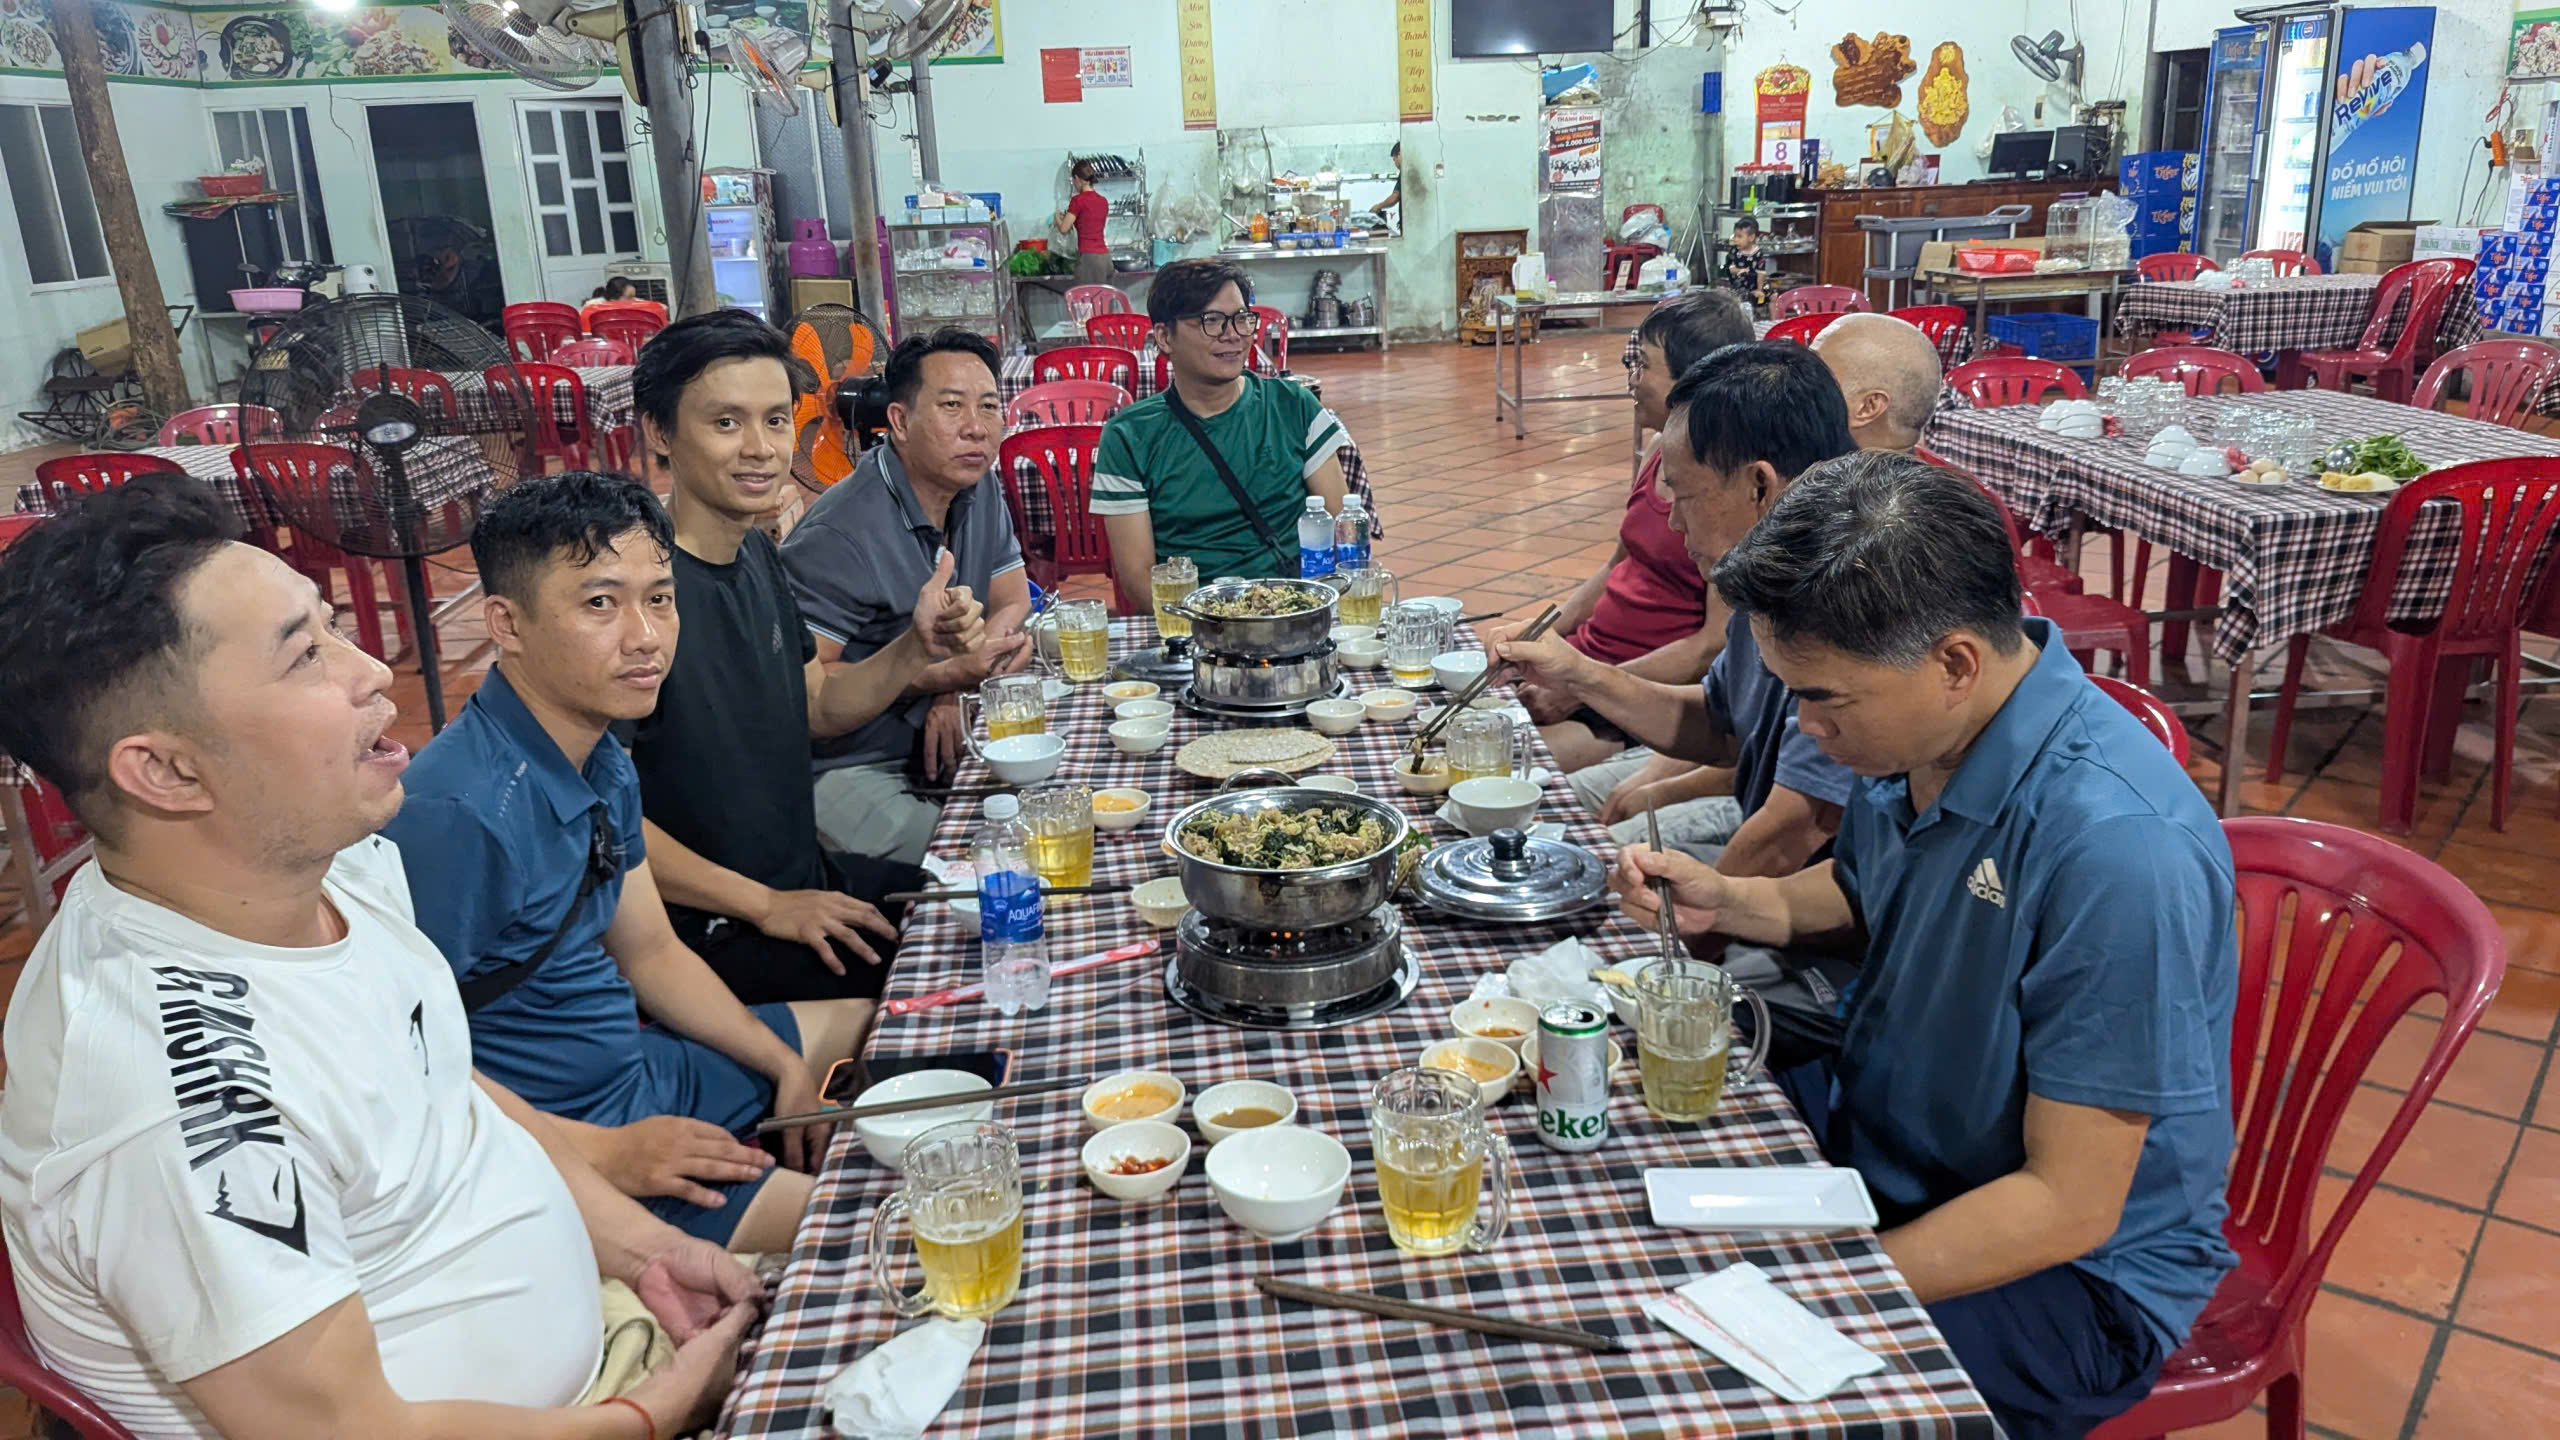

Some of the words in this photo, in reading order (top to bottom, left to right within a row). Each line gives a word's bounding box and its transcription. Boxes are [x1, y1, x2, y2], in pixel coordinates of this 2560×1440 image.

[2333, 70, 2393, 126] Revive
[1774, 141, 1788, 161] 8
[2153, 165, 2180, 180] Tiger
[2331, 158, 2353, 182] ĐỔ
[2355, 155, 2379, 179] MỒ
[2380, 155, 2406, 174] HÔI
[2331, 178, 2362, 201] NIỀM
[2363, 180, 2384, 195] VUI
[2384, 174, 2408, 192] TỚI
[2151, 209, 2178, 224] Tiger
